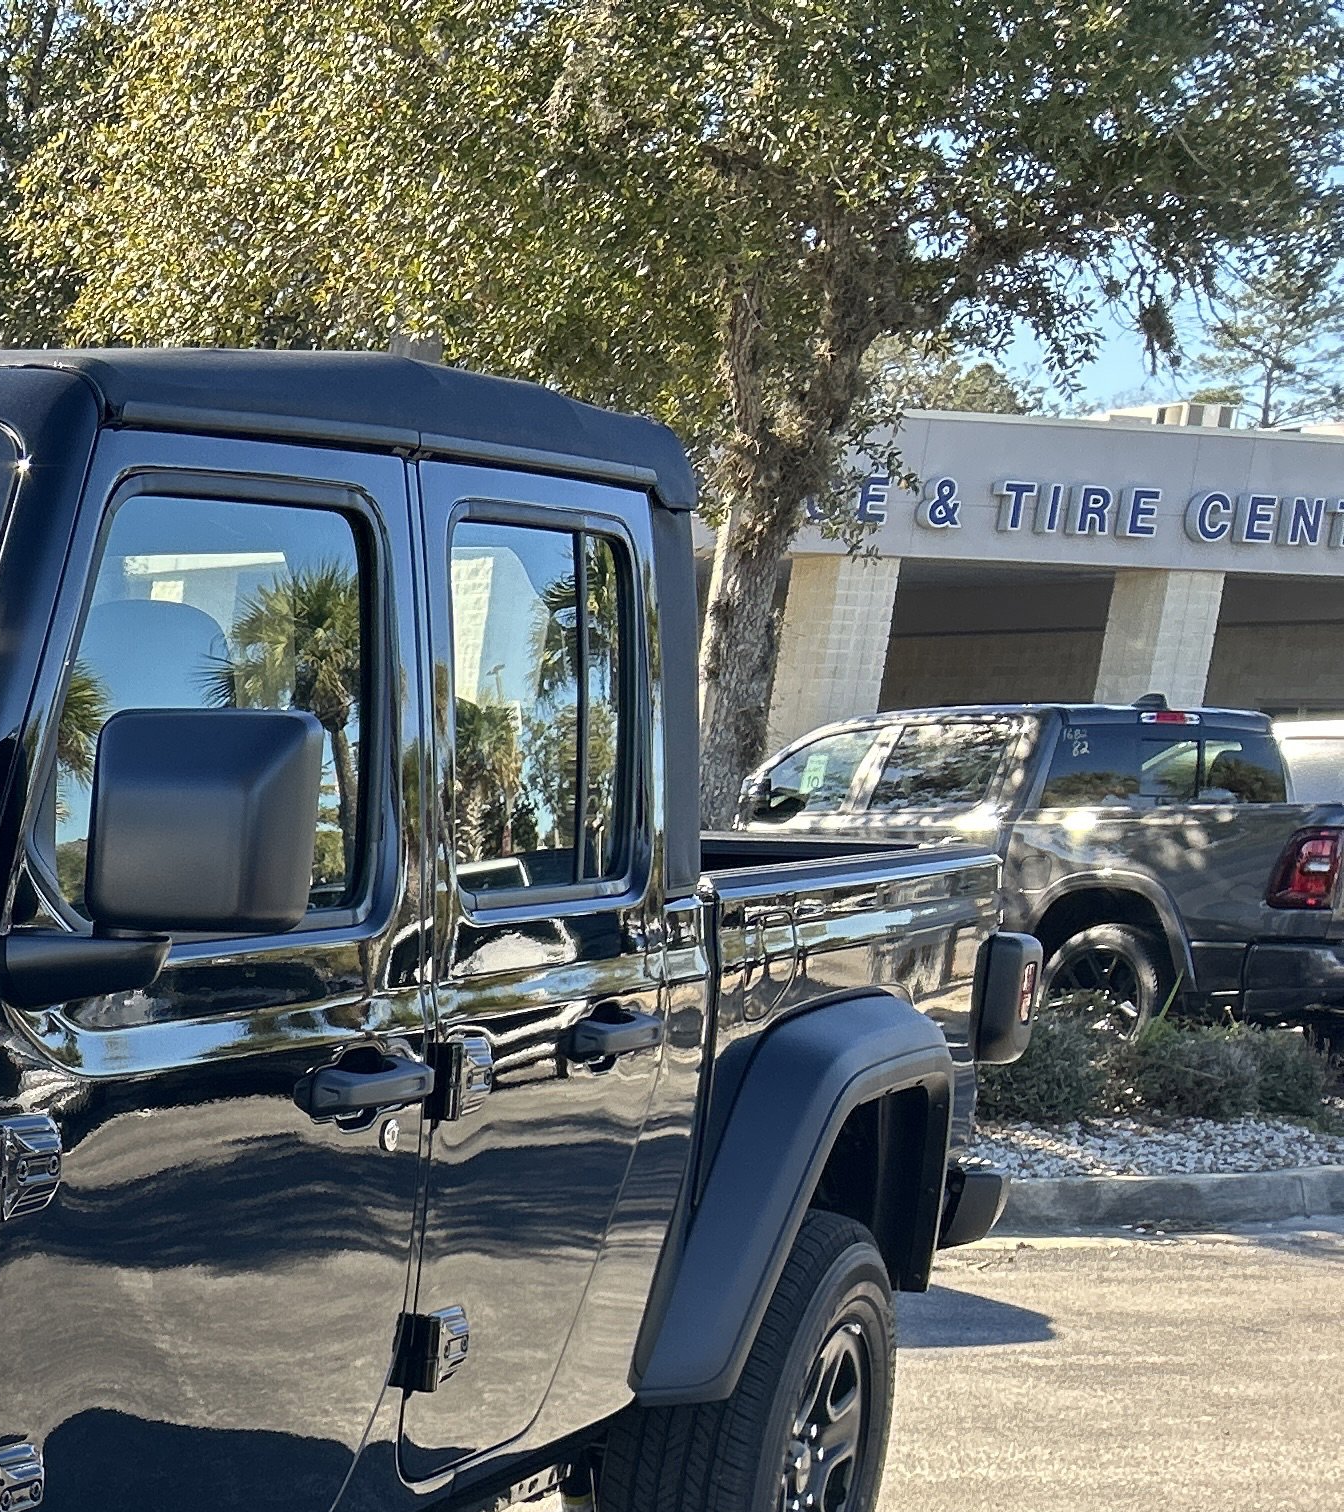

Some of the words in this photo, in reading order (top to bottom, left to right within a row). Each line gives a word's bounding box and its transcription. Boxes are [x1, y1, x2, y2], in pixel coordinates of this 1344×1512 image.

[927, 476, 962, 529] &
[1003, 480, 1162, 538] TIRE
[1197, 491, 1344, 547] CEN
